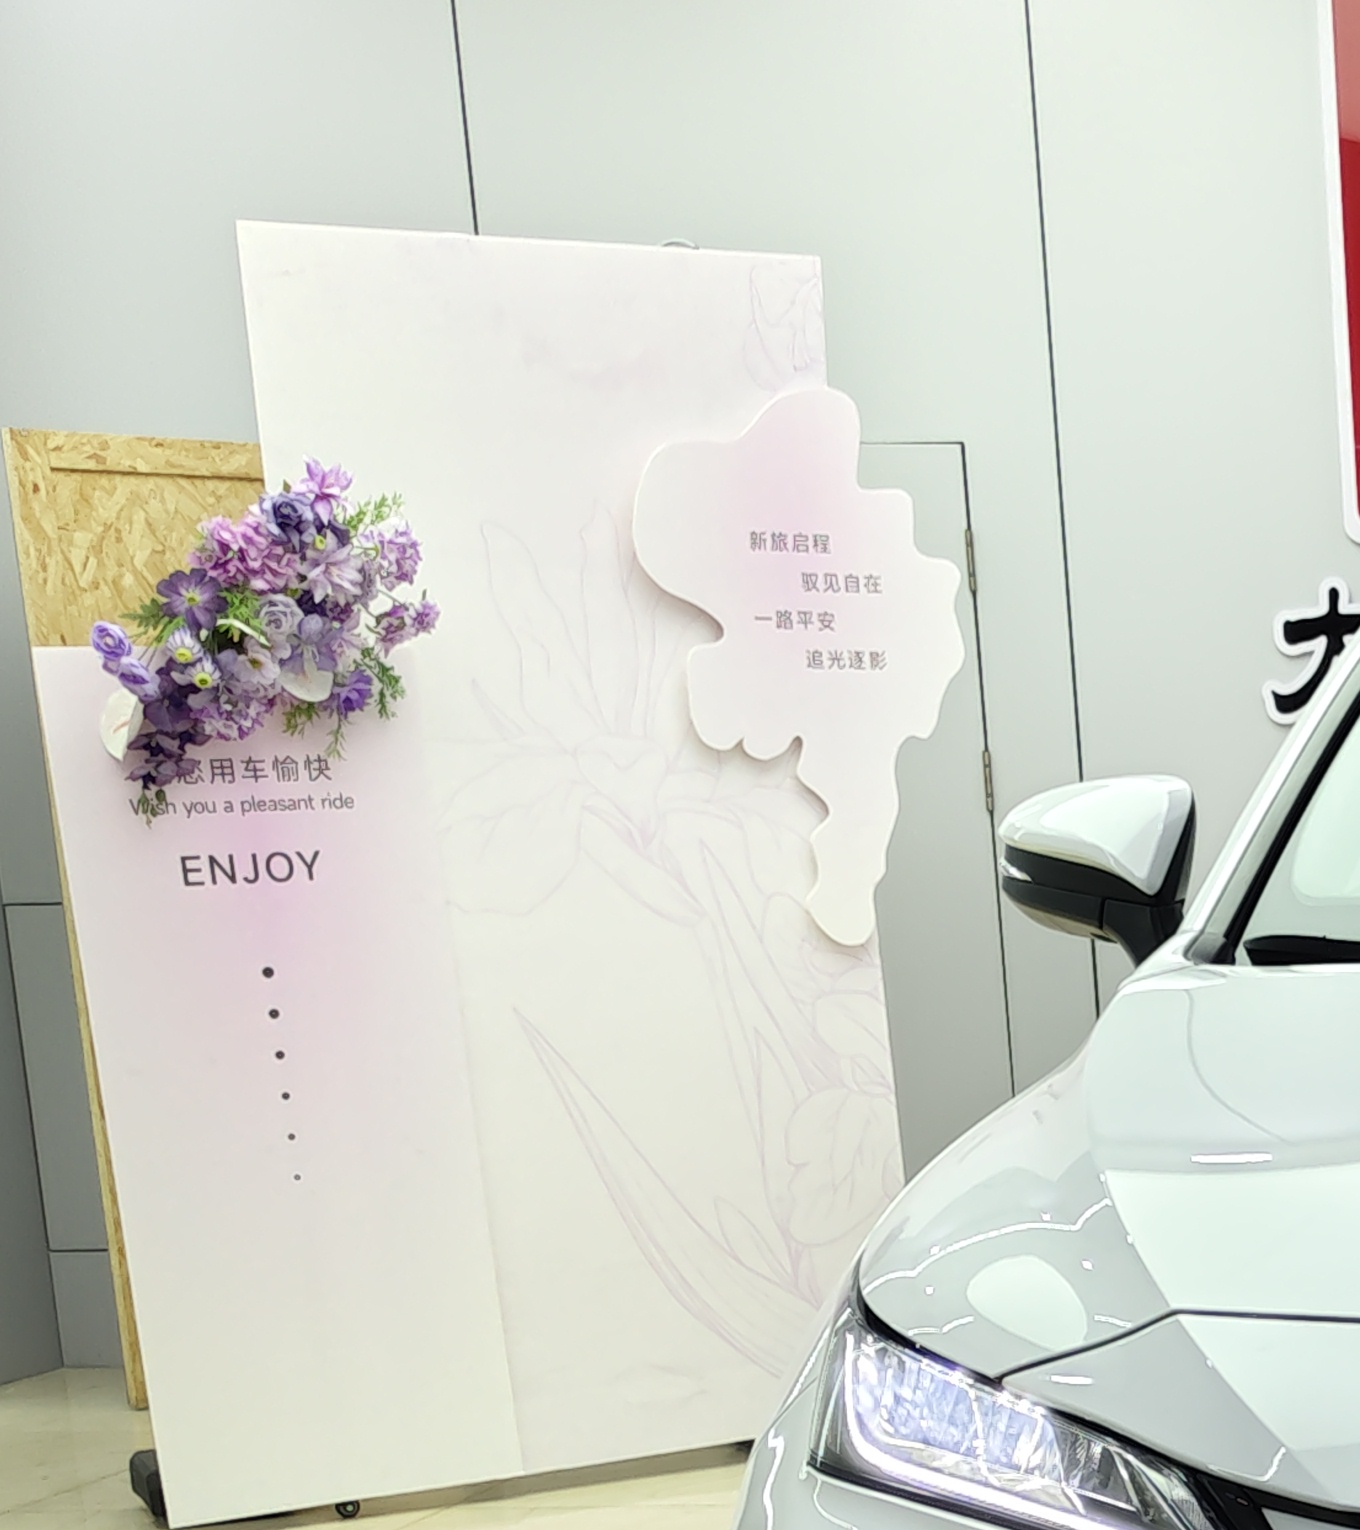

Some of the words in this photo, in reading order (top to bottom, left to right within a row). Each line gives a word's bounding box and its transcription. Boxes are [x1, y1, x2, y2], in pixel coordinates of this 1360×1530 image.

[749, 530, 831, 554] 新旅启程
[801, 572, 882, 594] 驭见自在
[754, 609, 836, 632] 一路平安
[806, 649, 888, 671] 追光逐影
[182, 800, 217, 819] you
[223, 800, 234, 813] a
[241, 795, 315, 816] pleasant
[321, 792, 355, 810] ride
[180, 850, 320, 887] ENJOY
